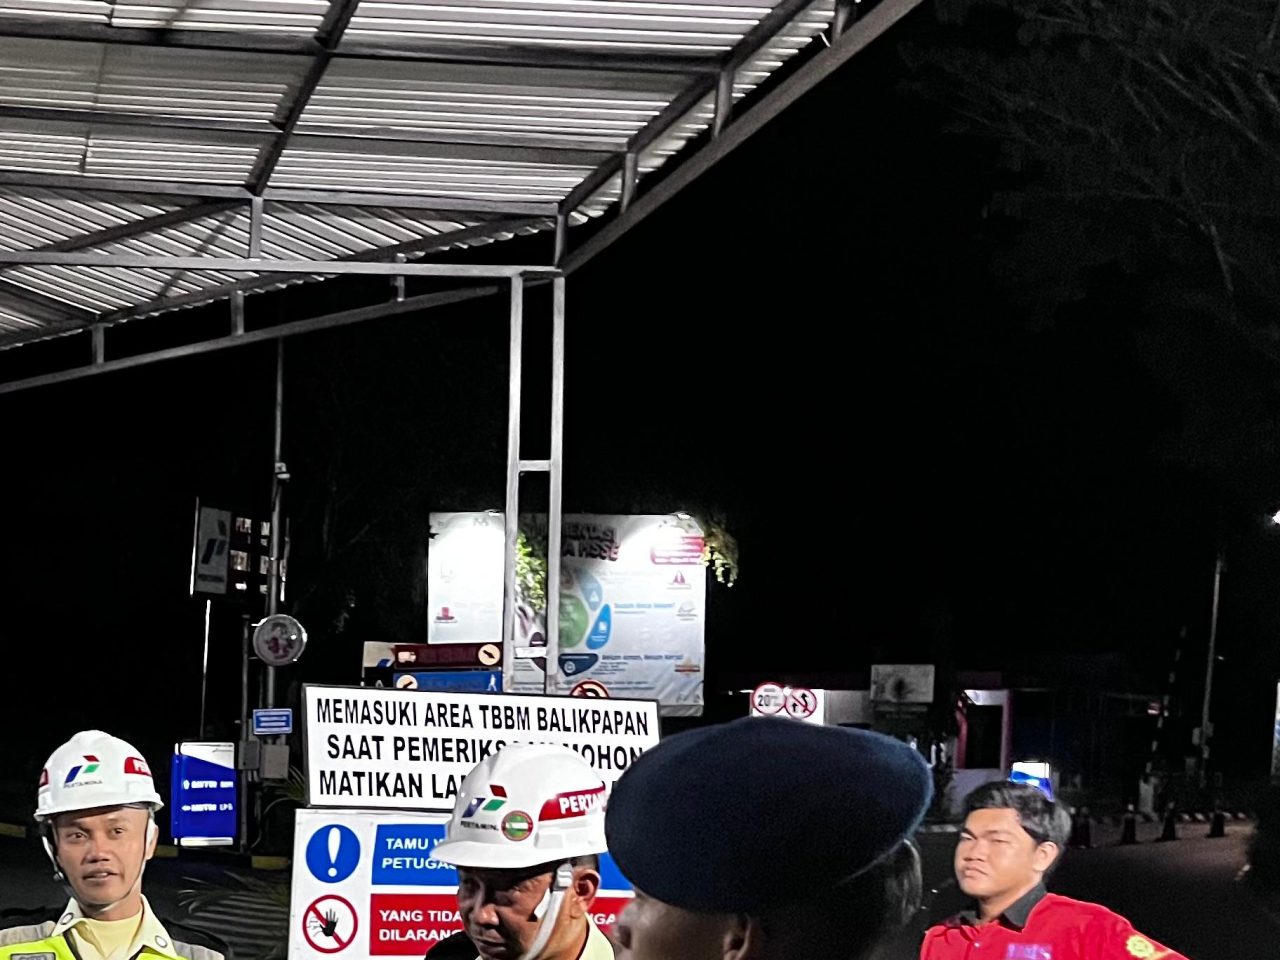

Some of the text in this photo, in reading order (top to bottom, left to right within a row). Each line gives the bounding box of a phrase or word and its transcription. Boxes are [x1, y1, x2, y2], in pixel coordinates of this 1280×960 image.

[317, 698, 417, 726] MEMASUKI
[424, 703, 474, 728] AREA
[479, 705, 531, 731] TBBM
[537, 707, 649, 736] BALIKPAPAN
[327, 734, 385, 760] SAAT
[320, 770, 467, 799] MATIKAN LA
[386, 838, 429, 850] TAMU
[379, 910, 463, 922] YANG TIDA
